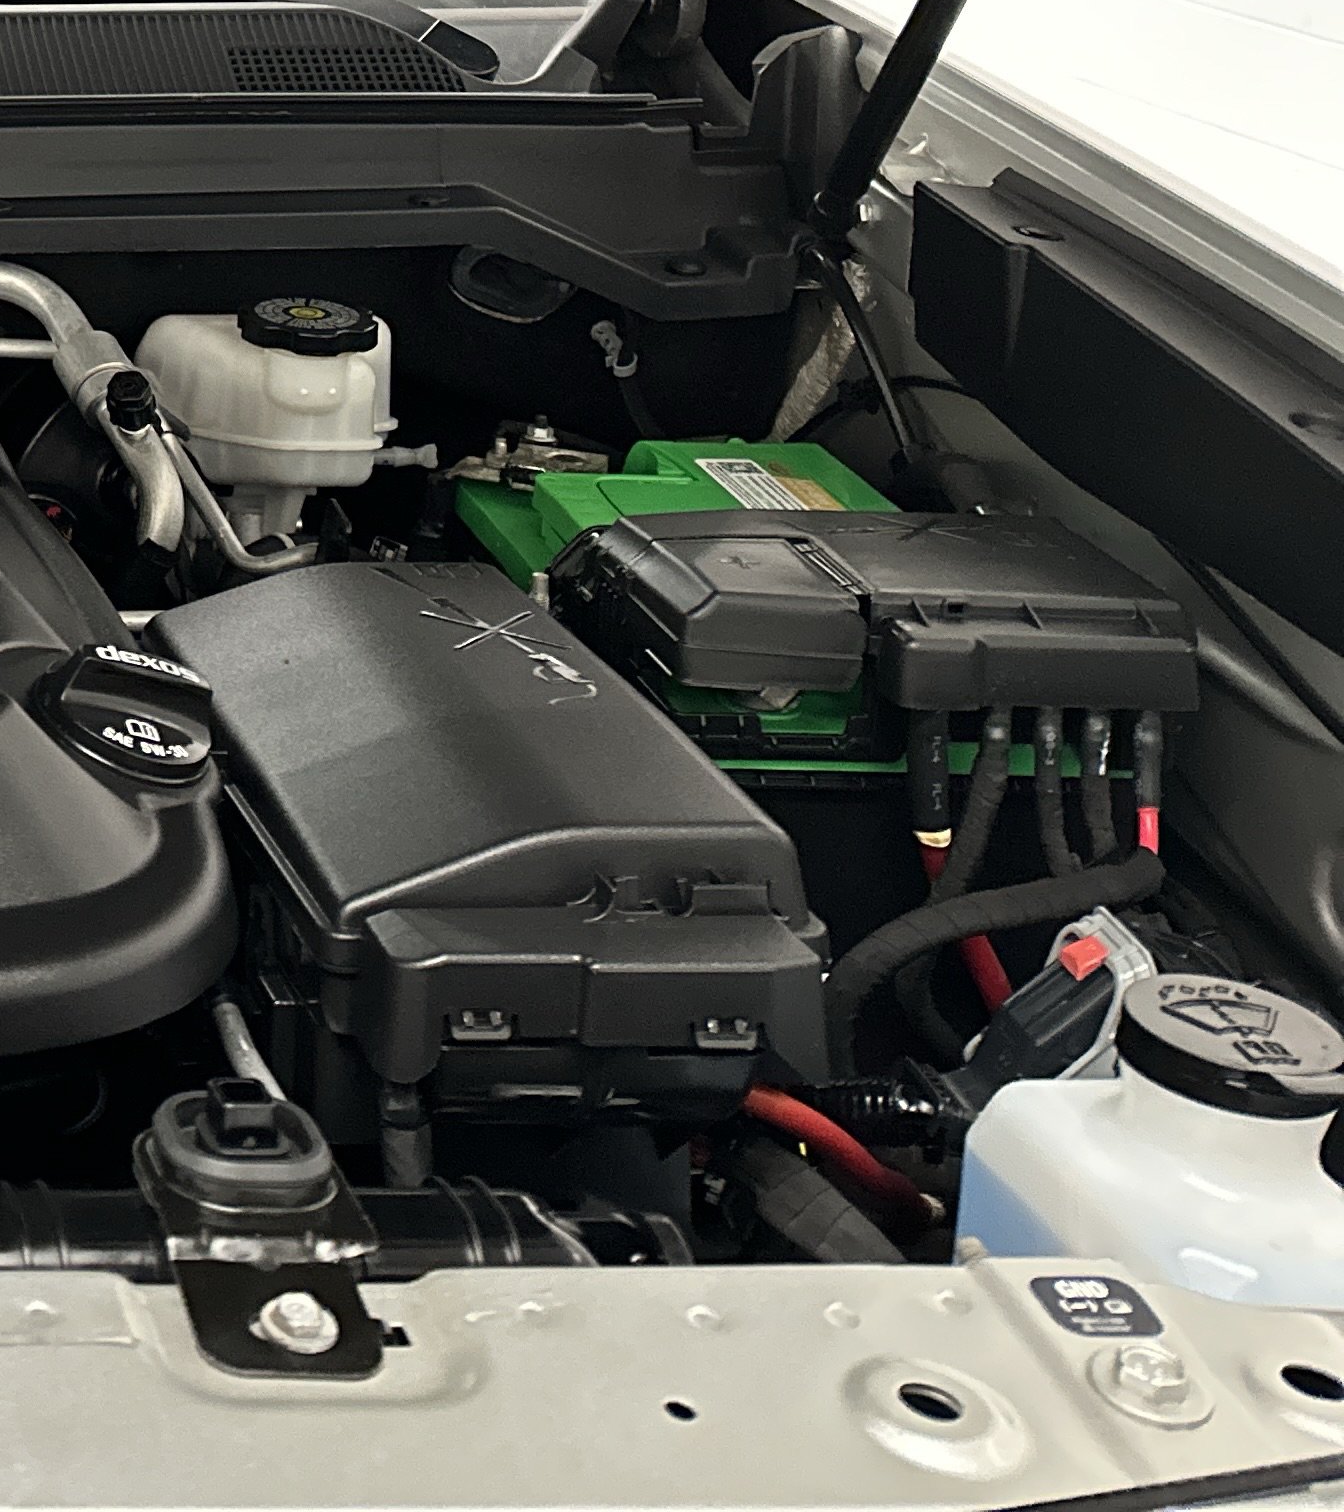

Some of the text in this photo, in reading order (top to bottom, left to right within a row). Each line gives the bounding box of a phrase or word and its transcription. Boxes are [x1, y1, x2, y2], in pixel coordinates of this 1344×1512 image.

[94, 644, 201, 683] dexos
[102, 726, 134, 749] SAE
[1053, 1279, 1110, 1299] GND
